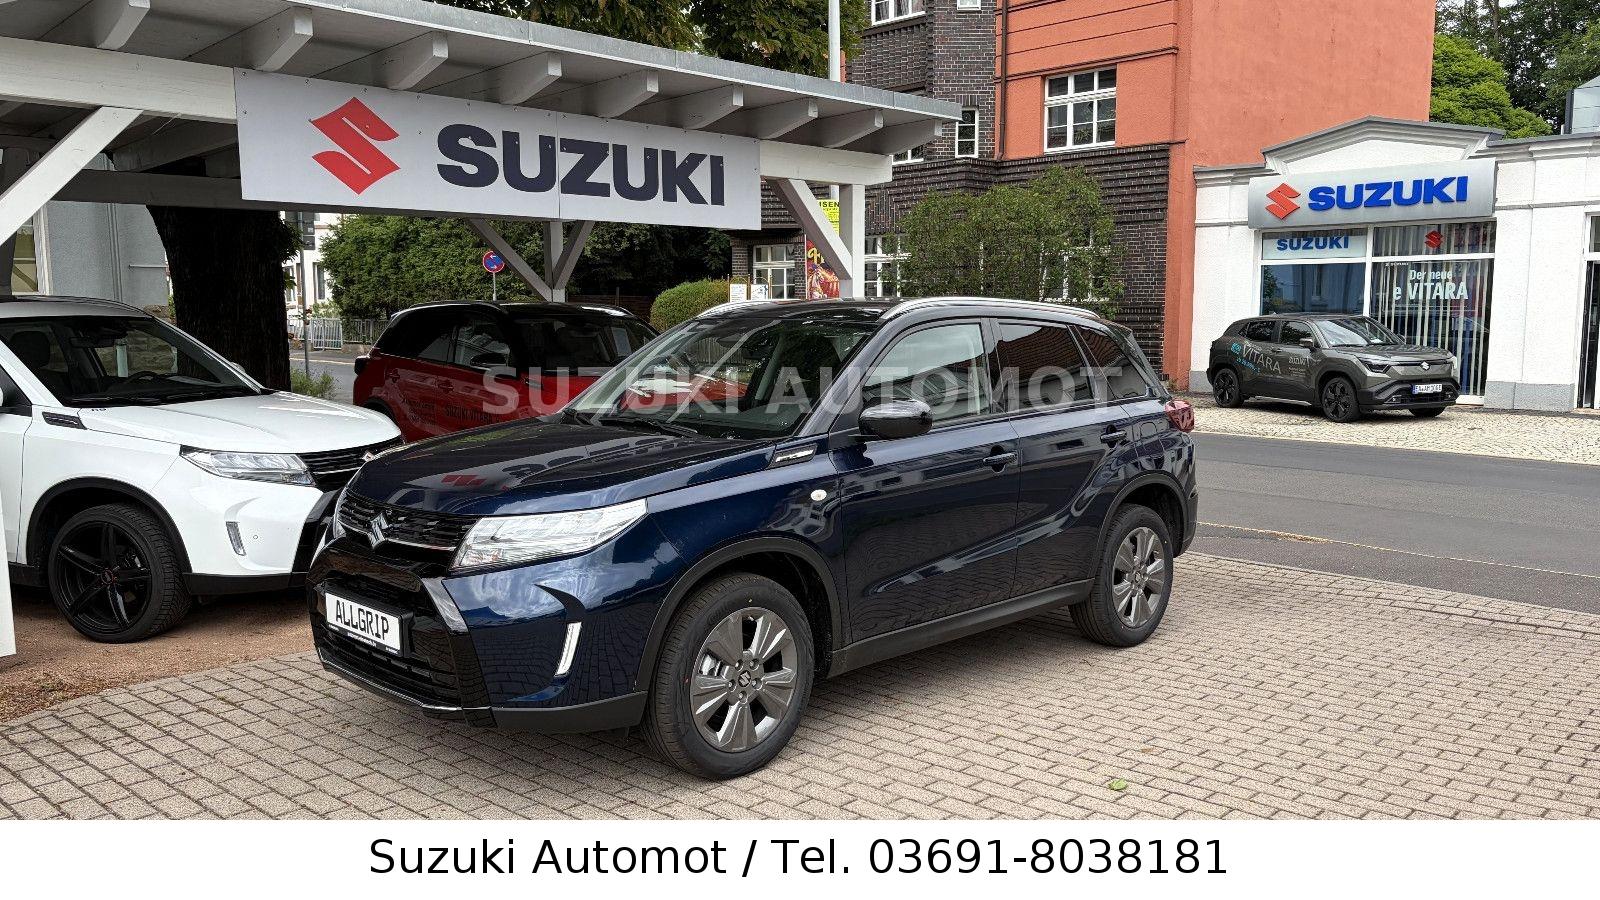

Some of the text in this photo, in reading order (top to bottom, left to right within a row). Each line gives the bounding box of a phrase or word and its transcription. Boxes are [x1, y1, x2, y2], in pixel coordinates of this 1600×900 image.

[436, 123, 726, 206] SUZUKI
[1307, 175, 1469, 212] SUZUKI
[1276, 235, 1350, 251] SUZUKI
[1409, 269, 1453, 280] Der neue
[1393, 281, 1469, 300] e VITARA
[1242, 344, 1283, 375] VITARA
[335, 599, 390, 641] ALLGRIP
